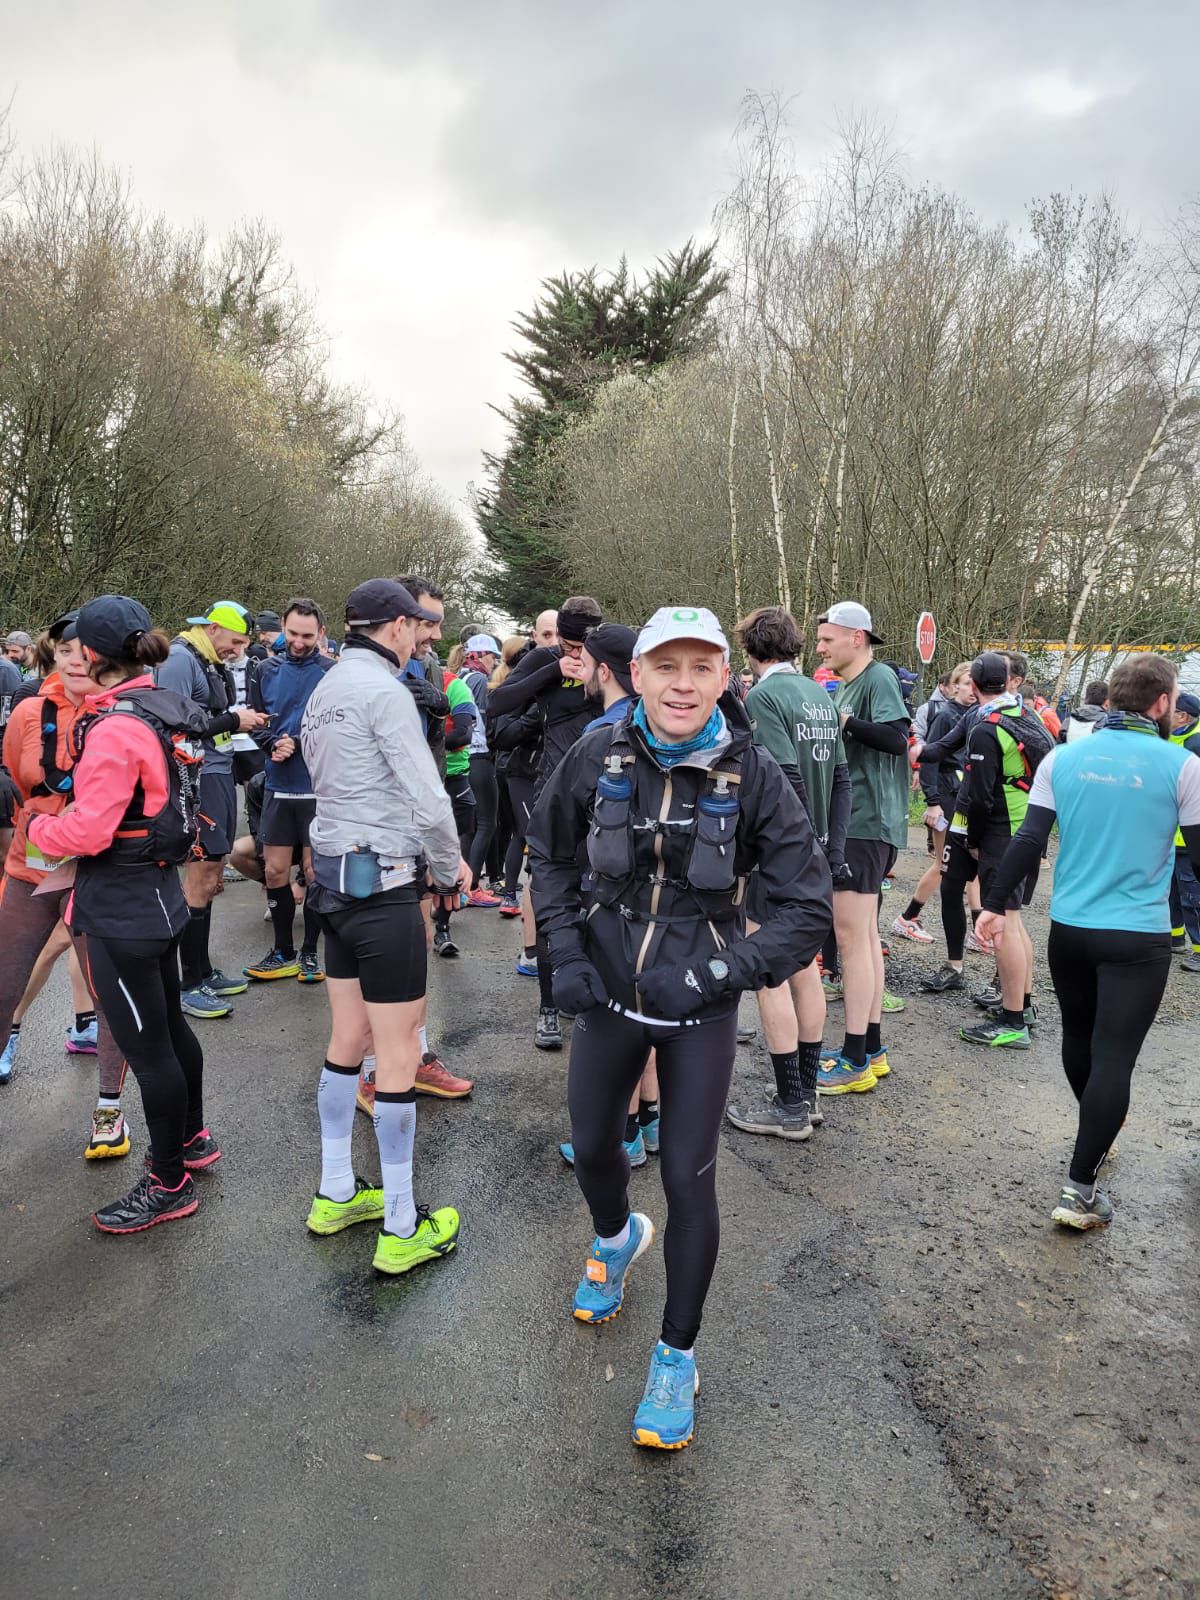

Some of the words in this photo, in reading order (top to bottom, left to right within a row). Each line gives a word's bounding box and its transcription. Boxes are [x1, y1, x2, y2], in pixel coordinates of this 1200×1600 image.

[920, 631, 934, 645] STOP
[308, 705, 345, 732] Cofidis
[802, 702, 833, 720] Sobhi
[812, 743, 830, 762] Cub
[942, 844, 951, 863] 6
